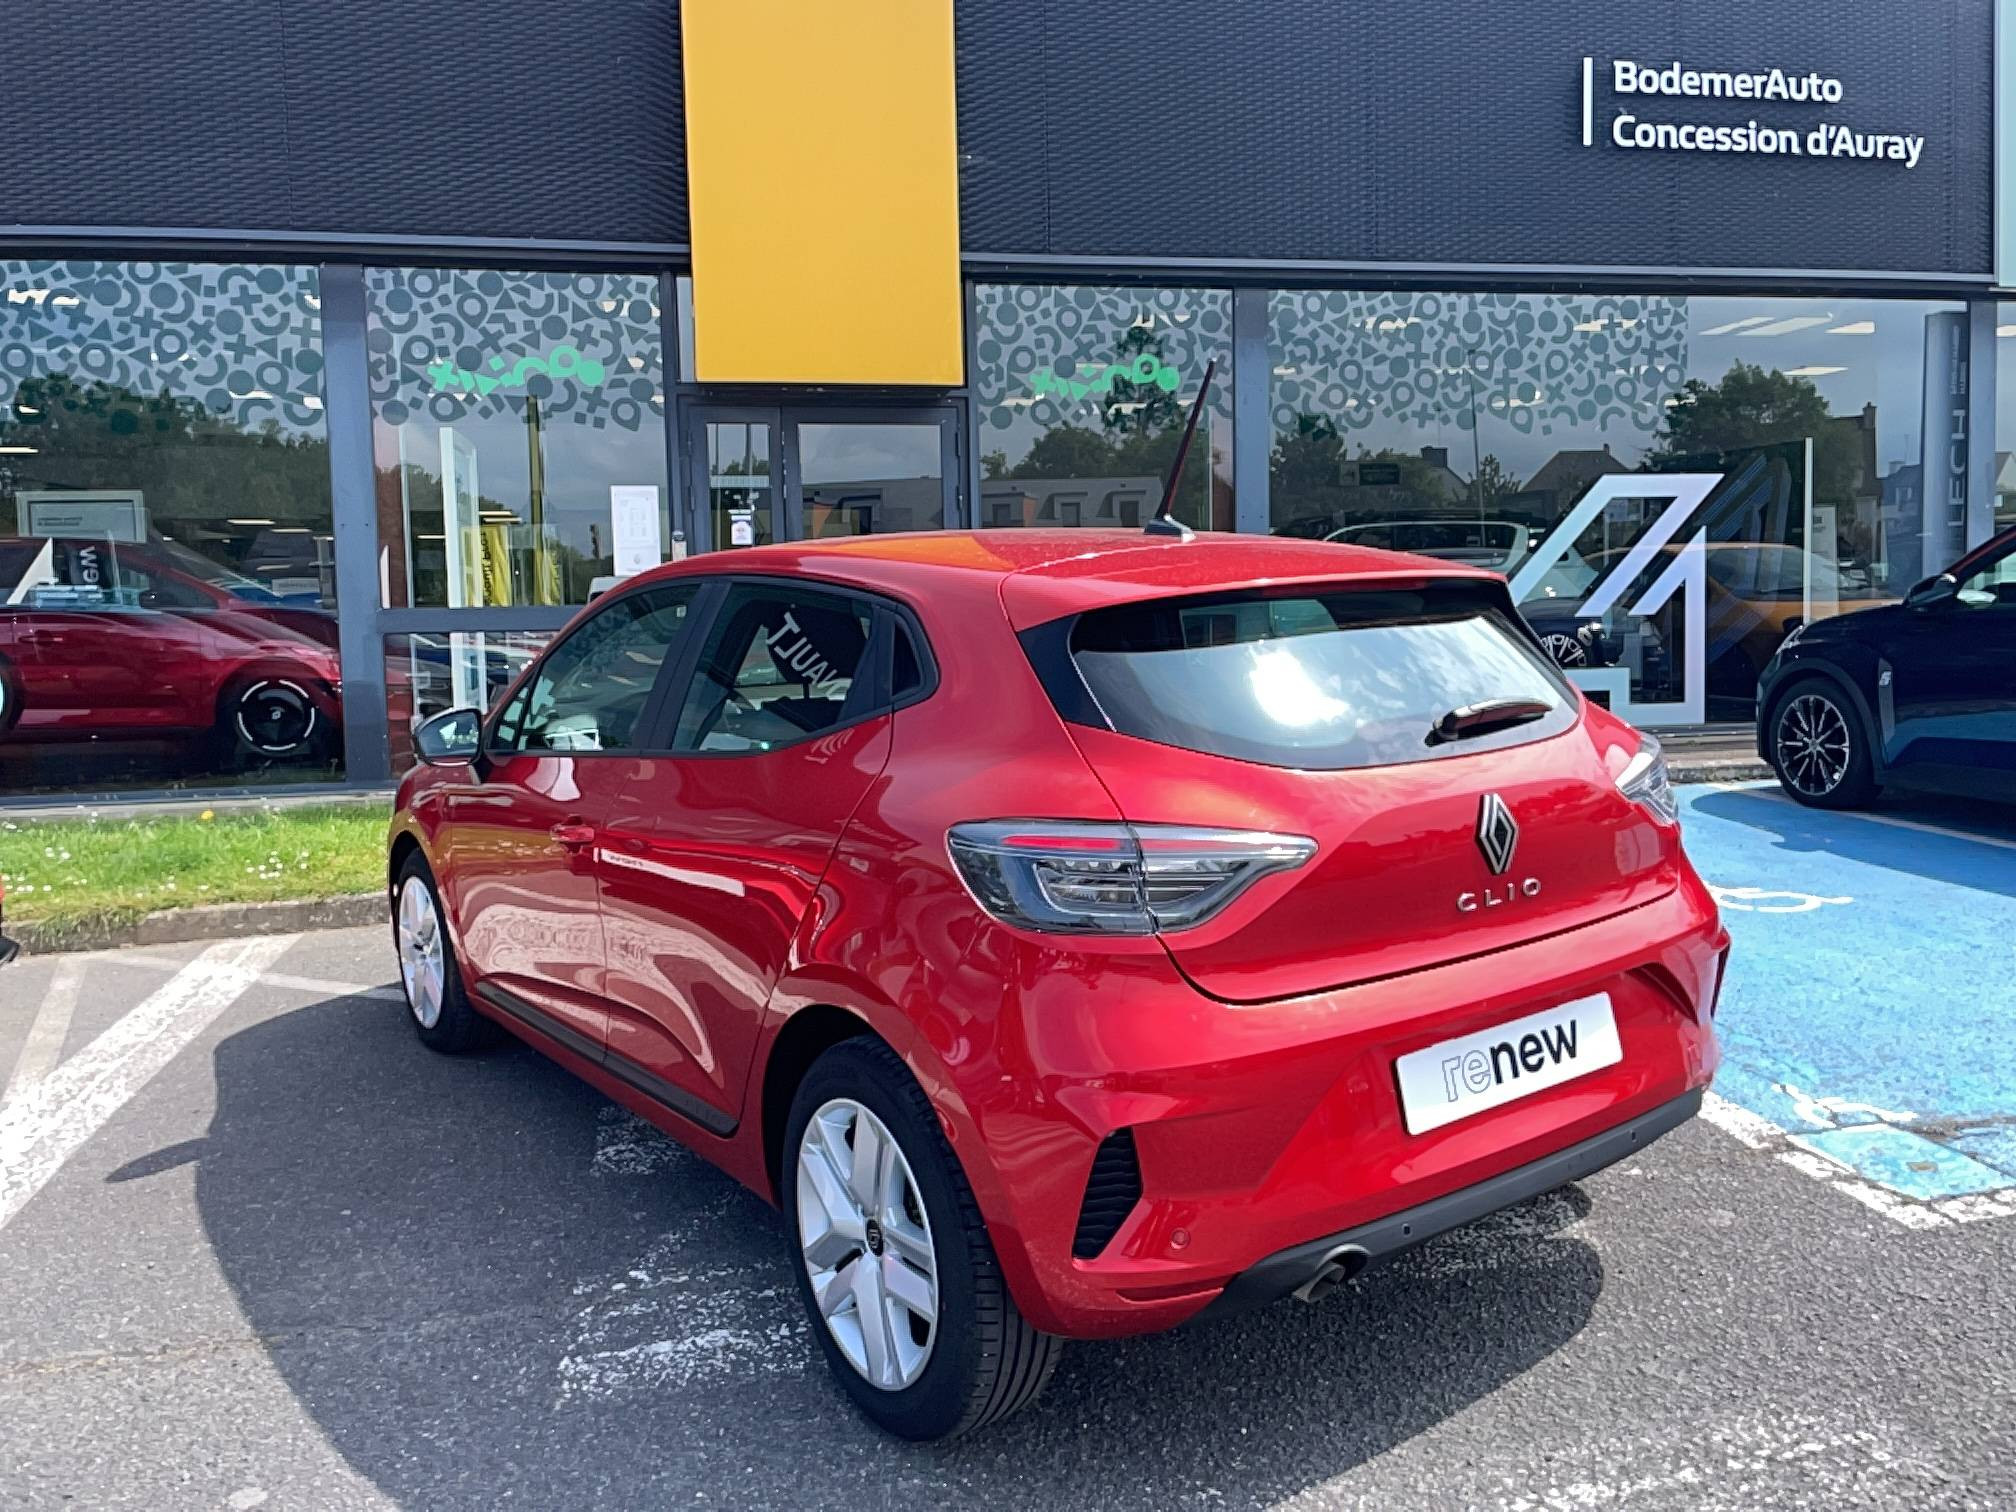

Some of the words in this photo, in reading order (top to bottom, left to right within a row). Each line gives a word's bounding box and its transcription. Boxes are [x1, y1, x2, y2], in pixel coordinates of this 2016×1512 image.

[1613, 60, 1843, 102] BodemerAuto
[1612, 115, 1801, 155] Concession
[1806, 124, 1925, 169] d'Auray
[1456, 877, 1541, 912] CLIO
[1442, 1019, 1577, 1102] renew
